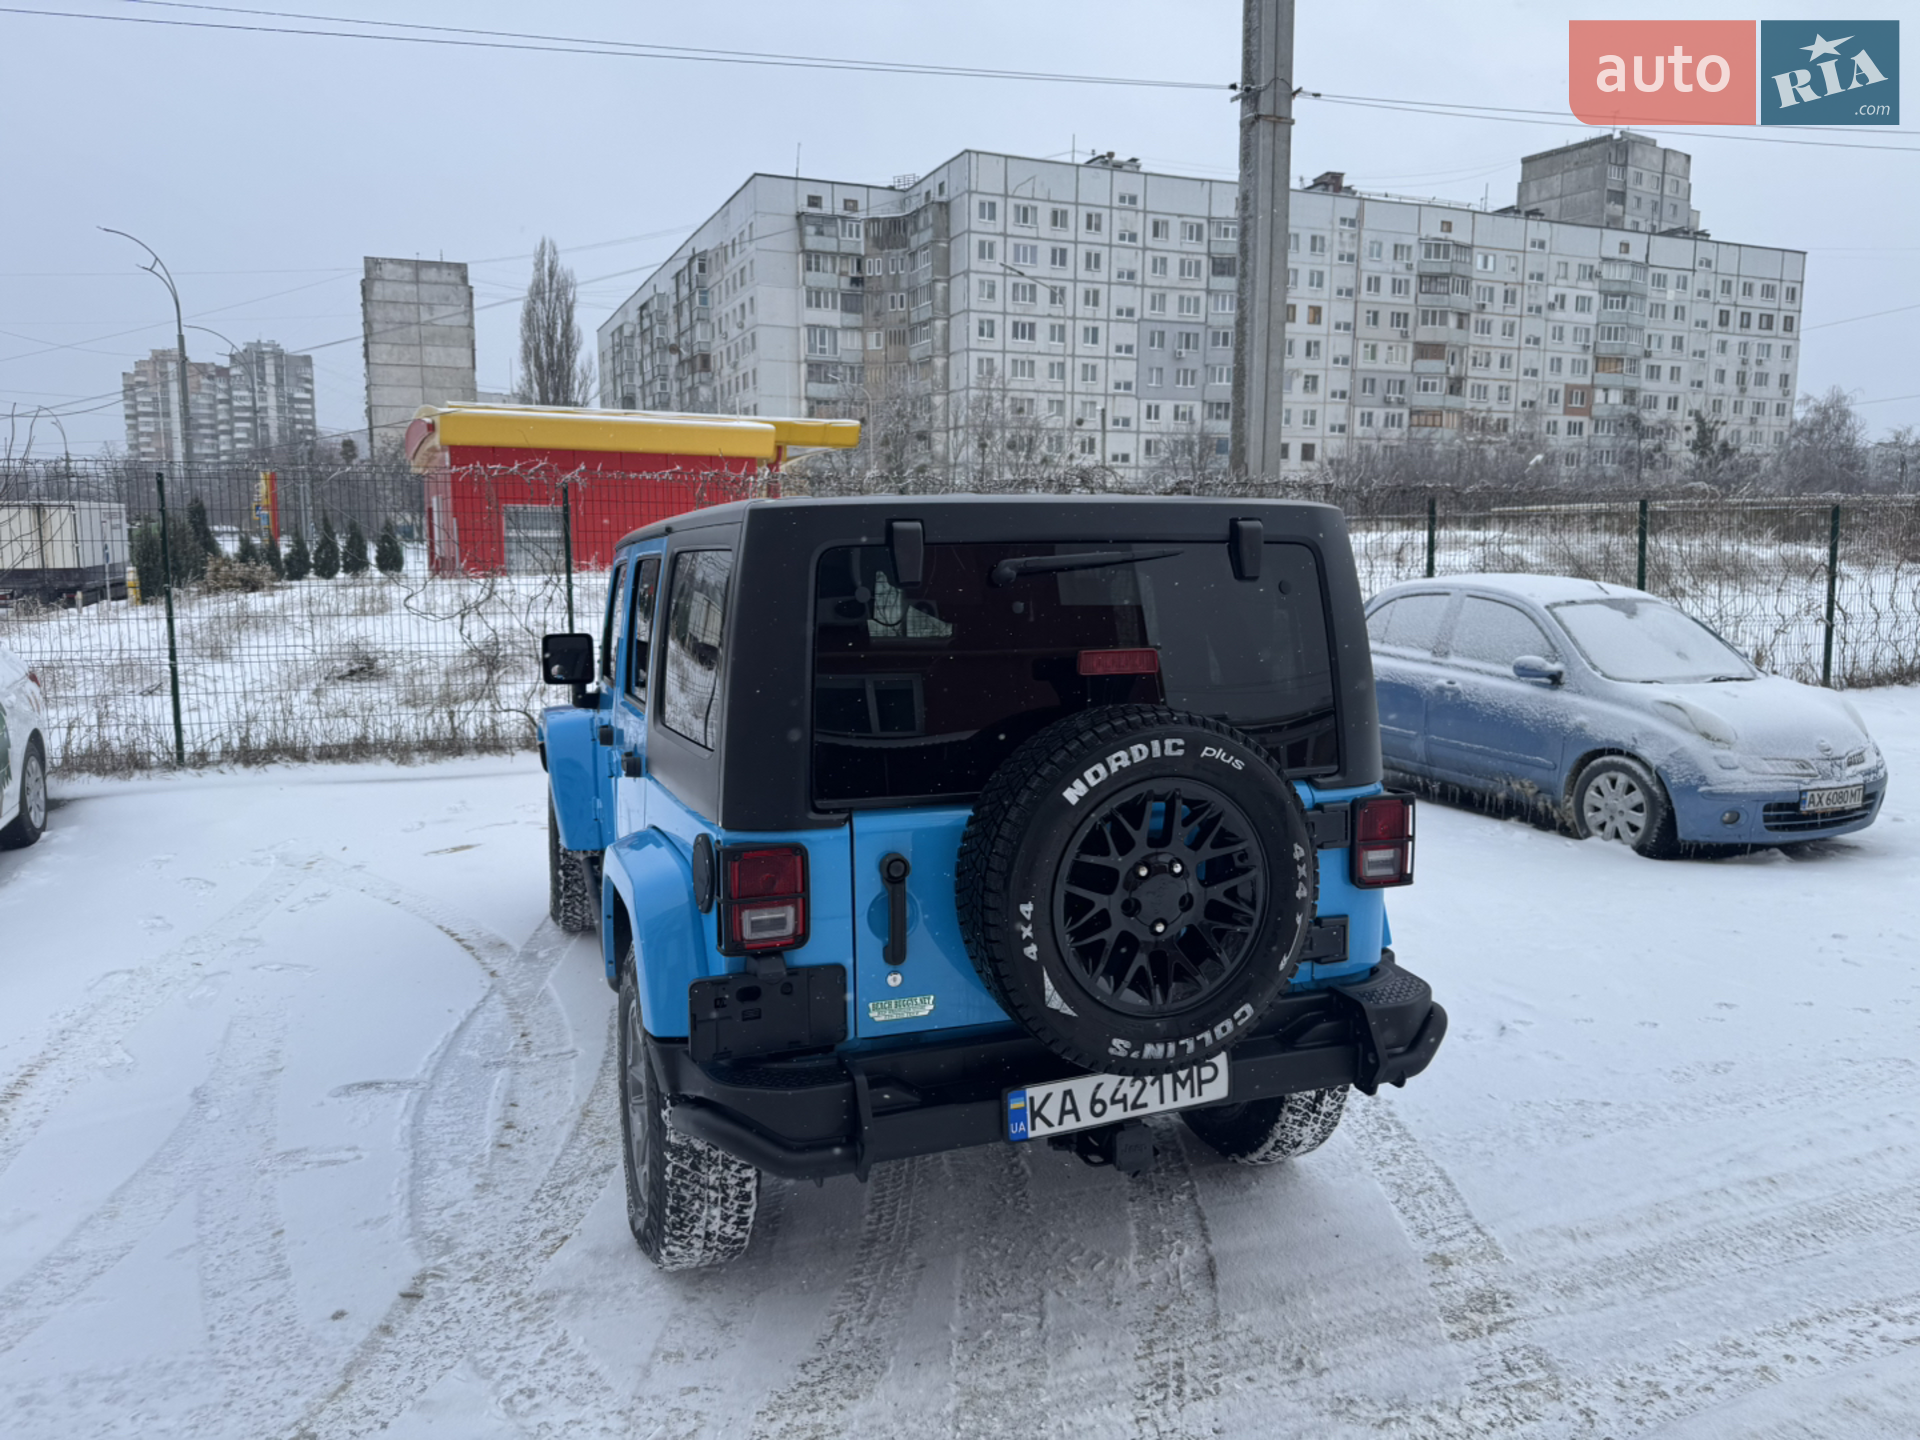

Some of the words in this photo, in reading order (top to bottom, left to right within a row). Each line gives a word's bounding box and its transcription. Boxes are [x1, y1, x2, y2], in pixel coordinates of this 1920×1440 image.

[1062, 738, 1185, 806] NORDIC
[1200, 745, 1246, 771] plus
[1808, 793, 1825, 808] AX
[1826, 790, 1848, 807] 6080
[1849, 788, 1863, 803] MT
[872, 1000, 893, 1012] BEACH
[1029, 1088, 1082, 1131] KA
[1089, 1077, 1166, 1118] 6421
[1172, 1063, 1219, 1102] MP
[1010, 1121, 1026, 1134] UA
